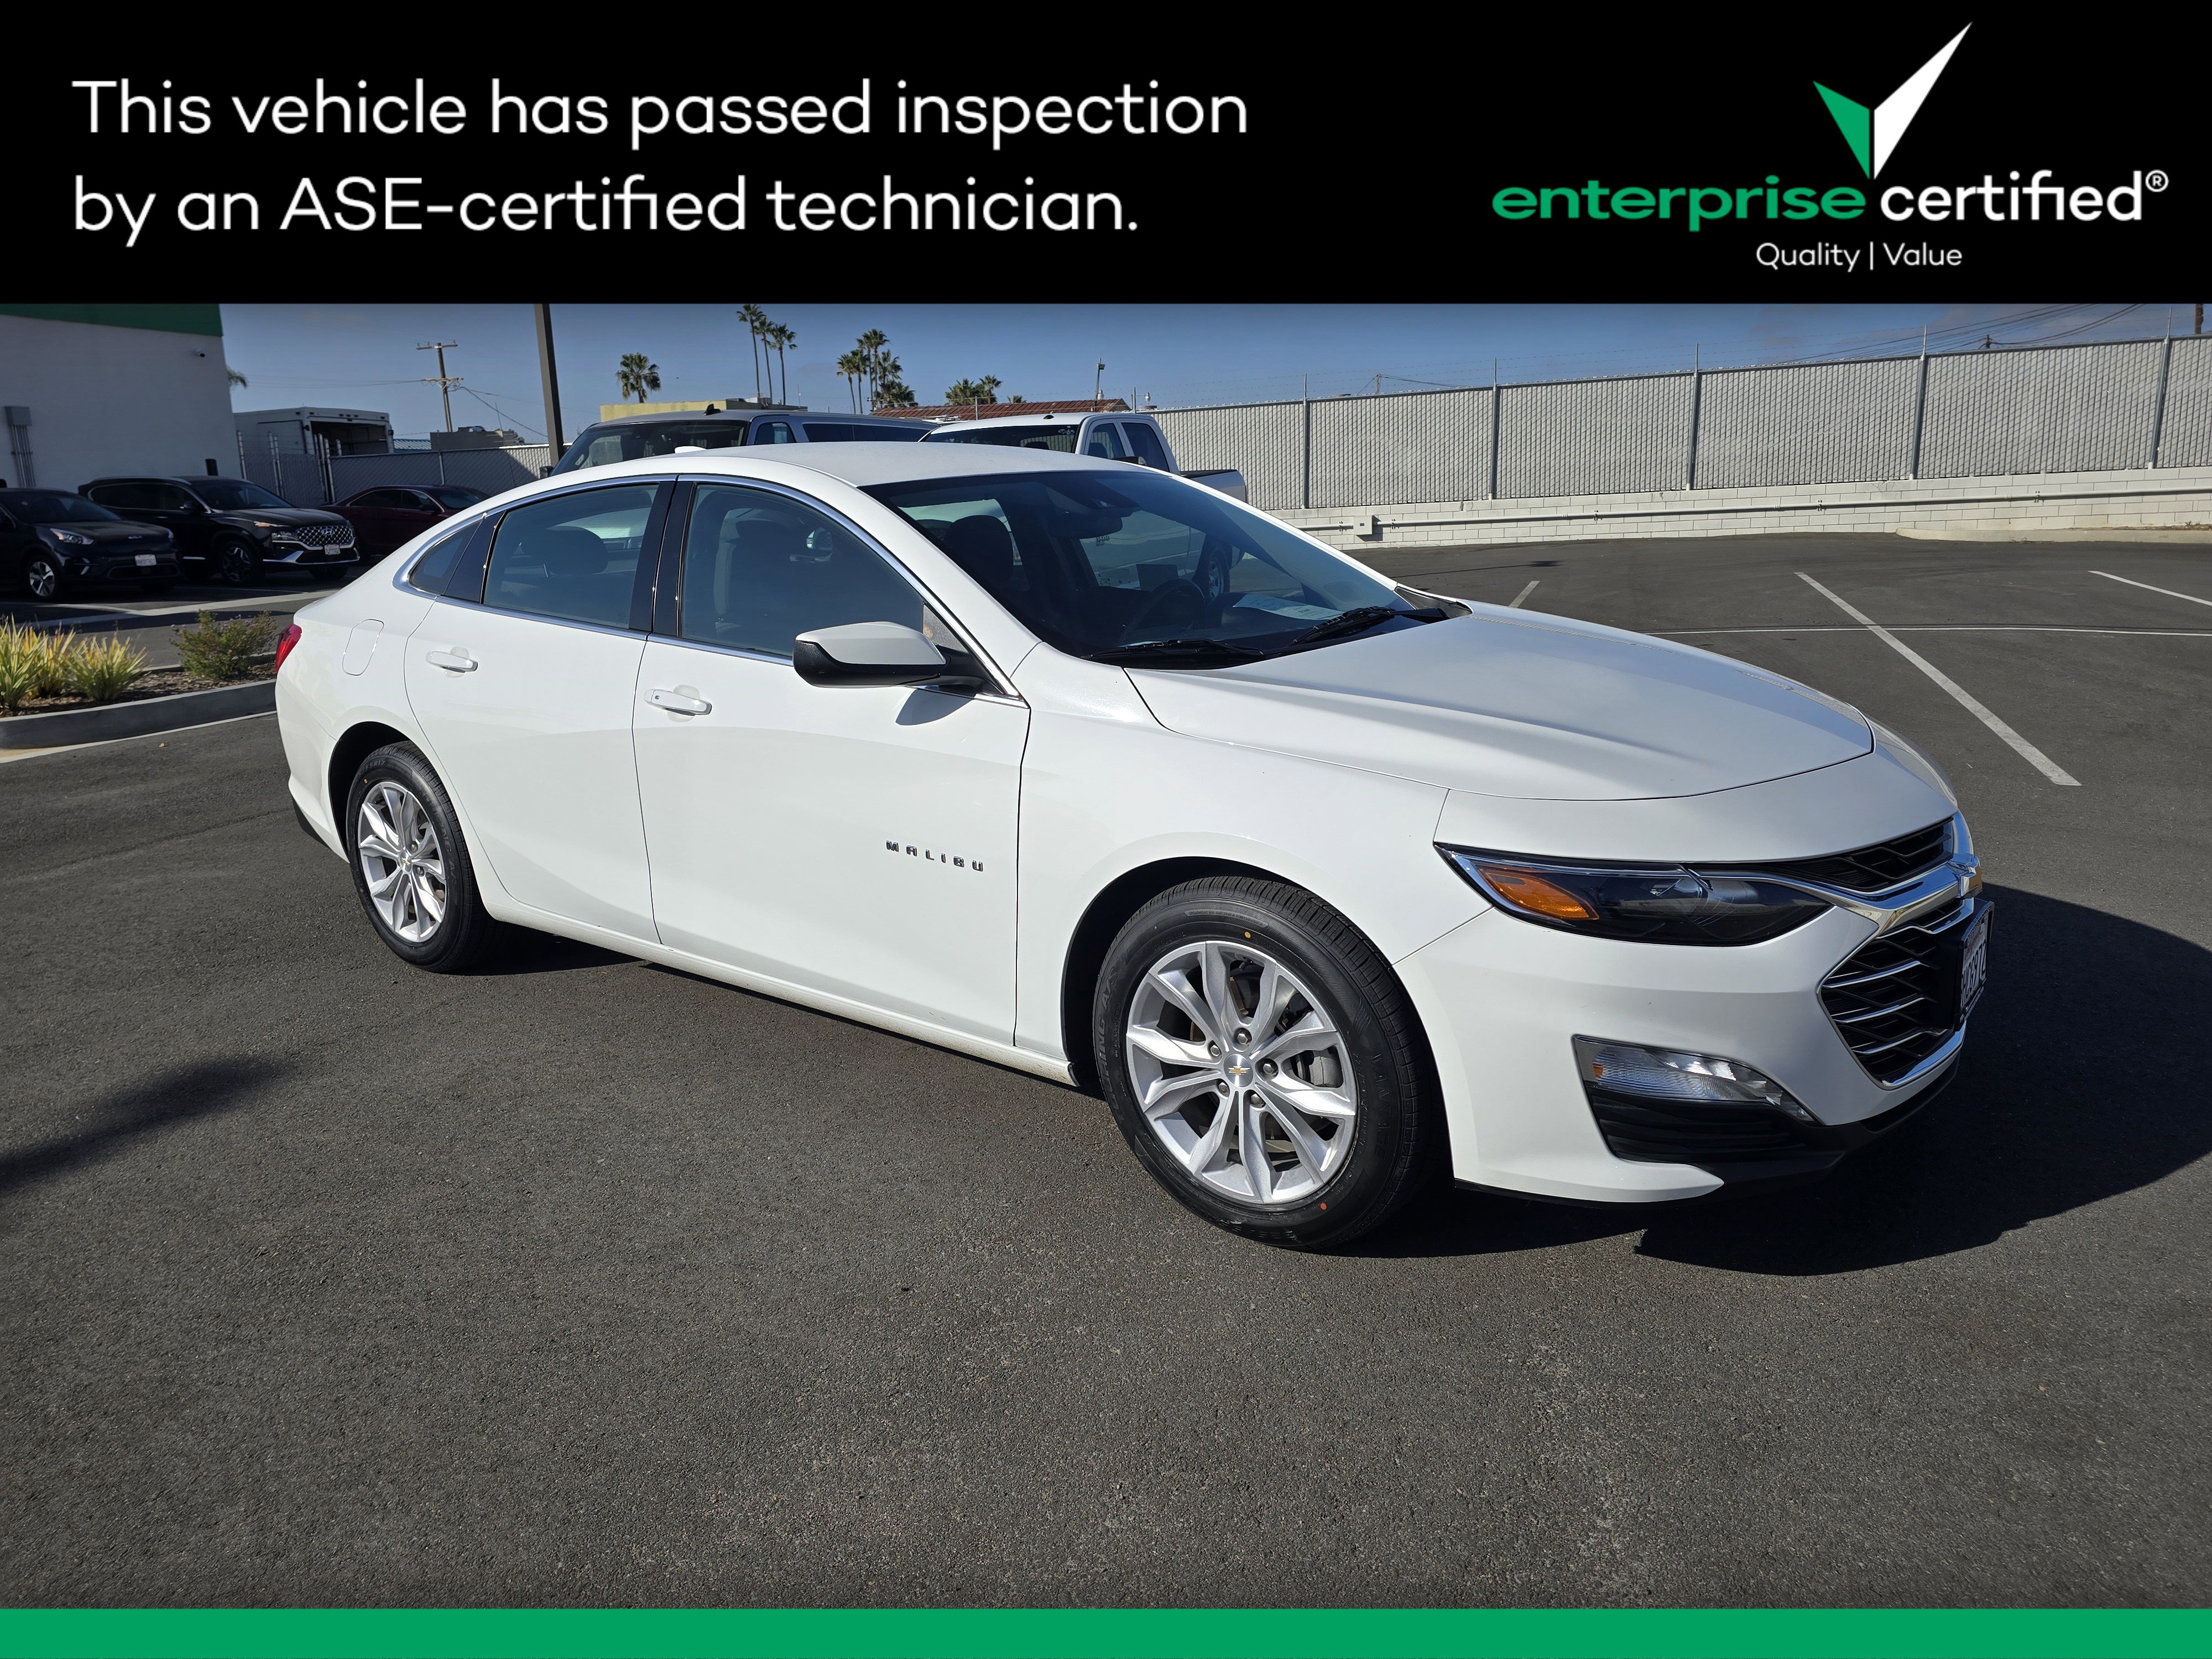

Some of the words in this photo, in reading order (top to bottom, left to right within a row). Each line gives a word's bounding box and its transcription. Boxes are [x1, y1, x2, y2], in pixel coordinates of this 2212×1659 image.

[886, 840, 983, 872] MALIBU
[1102, 967, 1118, 1011] A/S
[1098, 1016, 1125, 1124] TOURING
